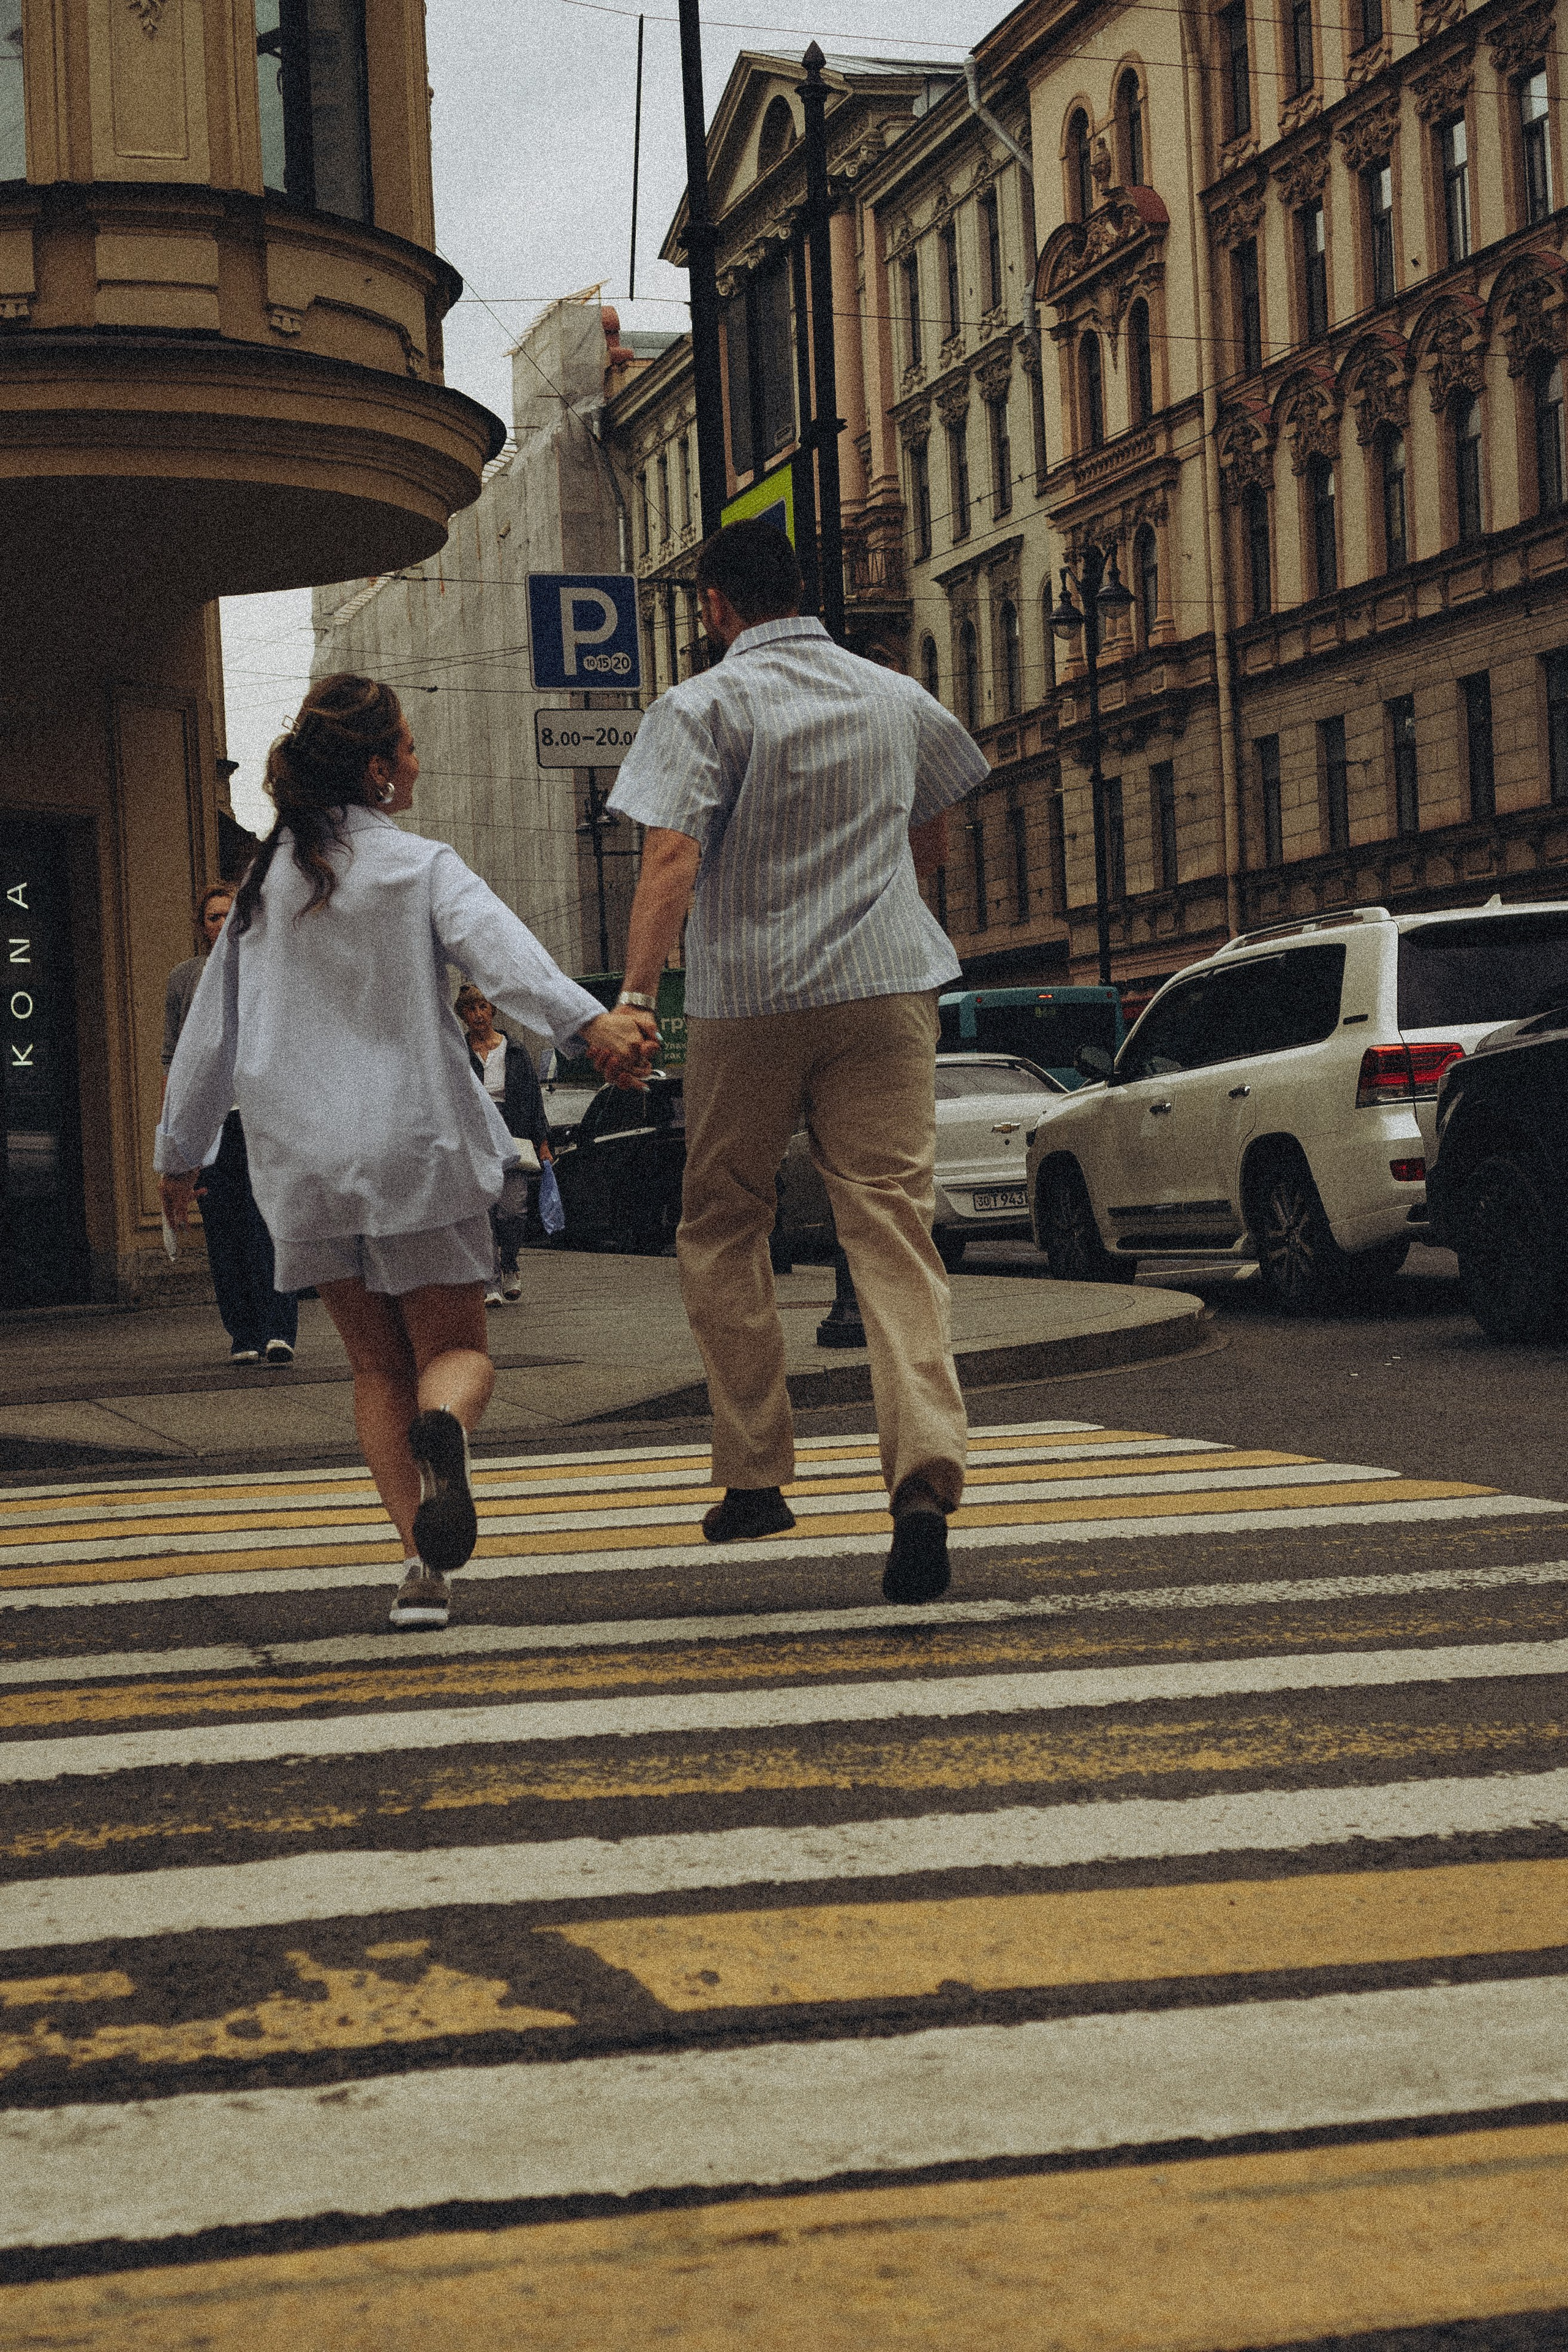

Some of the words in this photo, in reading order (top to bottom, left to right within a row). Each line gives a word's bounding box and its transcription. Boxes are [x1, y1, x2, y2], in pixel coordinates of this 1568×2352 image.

[560, 587, 618, 676] P
[598, 657, 609, 669] 15
[613, 656, 630, 670] 20
[7, 882, 33, 1066] KONA
